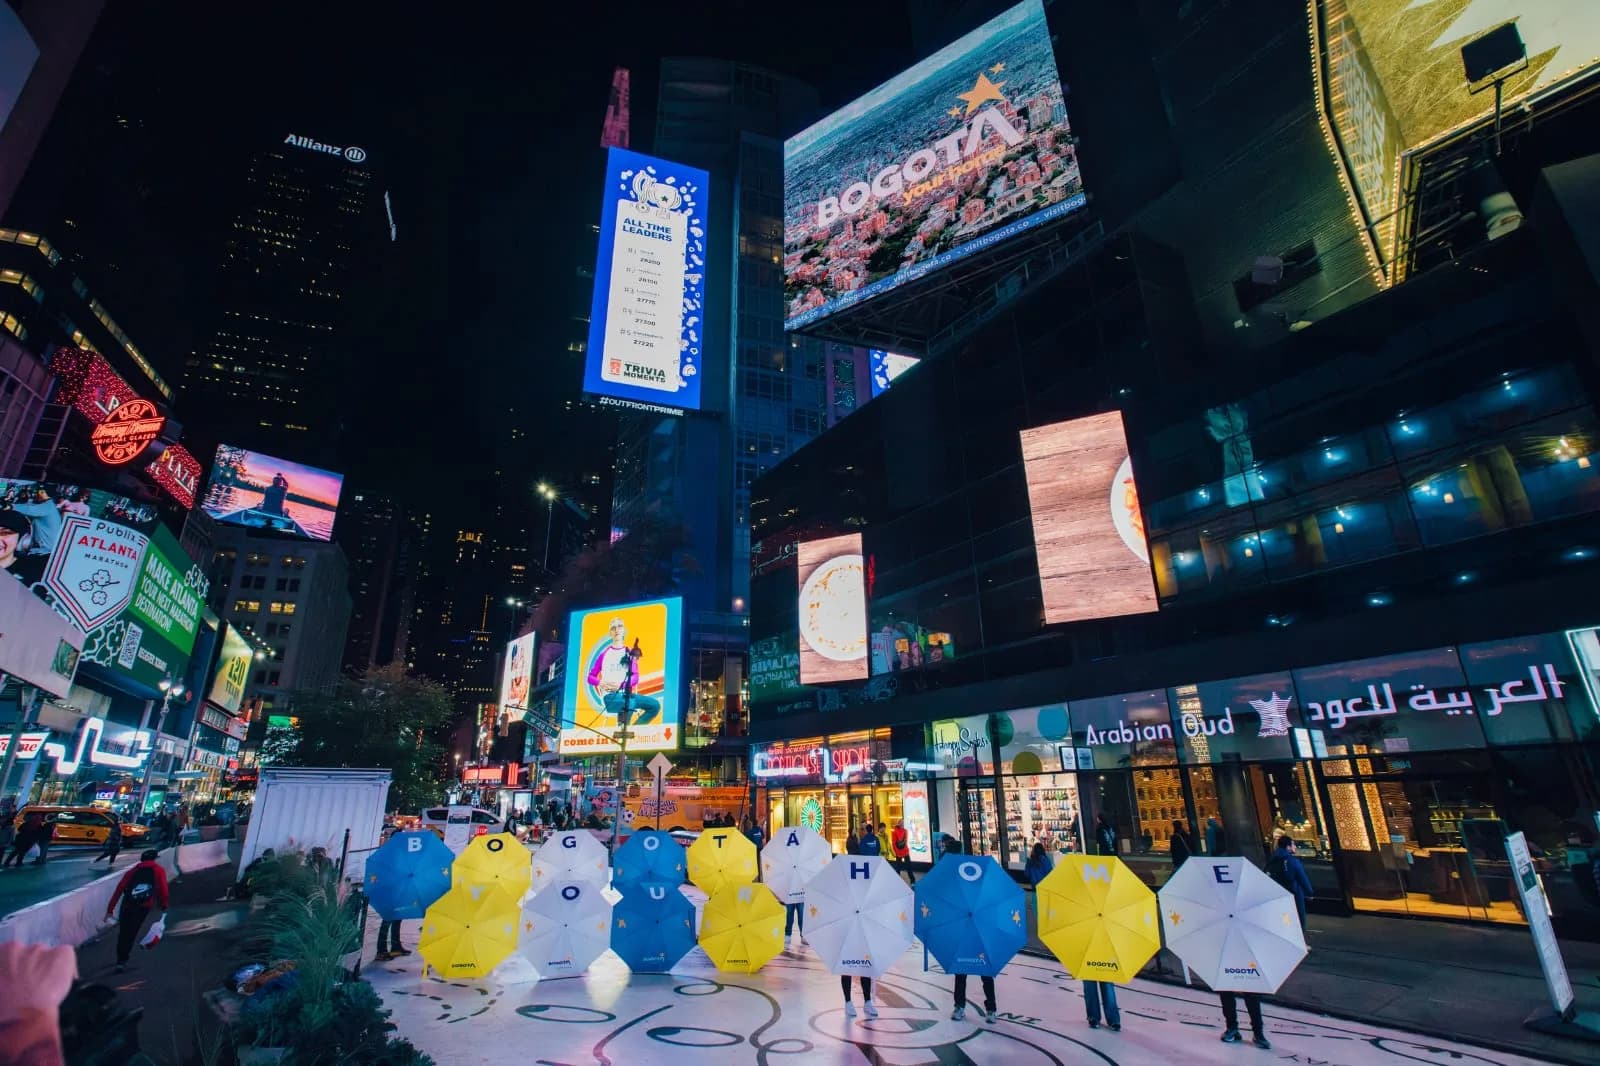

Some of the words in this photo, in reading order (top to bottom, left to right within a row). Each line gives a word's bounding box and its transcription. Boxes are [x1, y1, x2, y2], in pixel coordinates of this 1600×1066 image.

[284, 134, 342, 156] Allianz
[904, 174, 951, 206] your
[952, 144, 1007, 176] home
[622, 225, 673, 242] LEADERS
[623, 217, 645, 229] ALL
[646, 222, 672, 235] TIME
[964, 220, 1030, 253] visitbogota.co
[623, 371, 666, 383] MOMENTS
[624, 363, 666, 377] TRIVIA
[118, 402, 150, 420] HOT
[599, 396, 684, 416] #OUTFRONTPRIME
[104, 441, 138, 459] NOW
[96, 521, 137, 543] Publix
[77, 535, 137, 561] ATLANTA
[140, 575, 158, 600] YOUR
[156, 590, 172, 612] NEXT
[145, 552, 172, 591] MAKE
[169, 579, 199, 620] ATLANTA
[1410, 663, 1565, 717] العربية
[1308, 682, 1398, 729] للعود
[1085, 720, 1173, 746] Arabian
[1181, 706, 1235, 738] Oud
[563, 736, 593, 747] come
[596, 736, 609, 746] in
[407, 837, 423, 852] B
[486, 838, 504, 852] O
[562, 835, 577, 849] G
[643, 836, 660, 850] O
[712, 835, 728, 848] T
[786, 830, 800, 847] Á
[850, 862, 870, 880] H
[958, 861, 983, 882] O
[1082, 863, 1111, 883] M
[1212, 865, 1233, 884] E
[469, 884, 485, 898] Y
[561, 885, 580, 900] O
[649, 887, 665, 900] U
